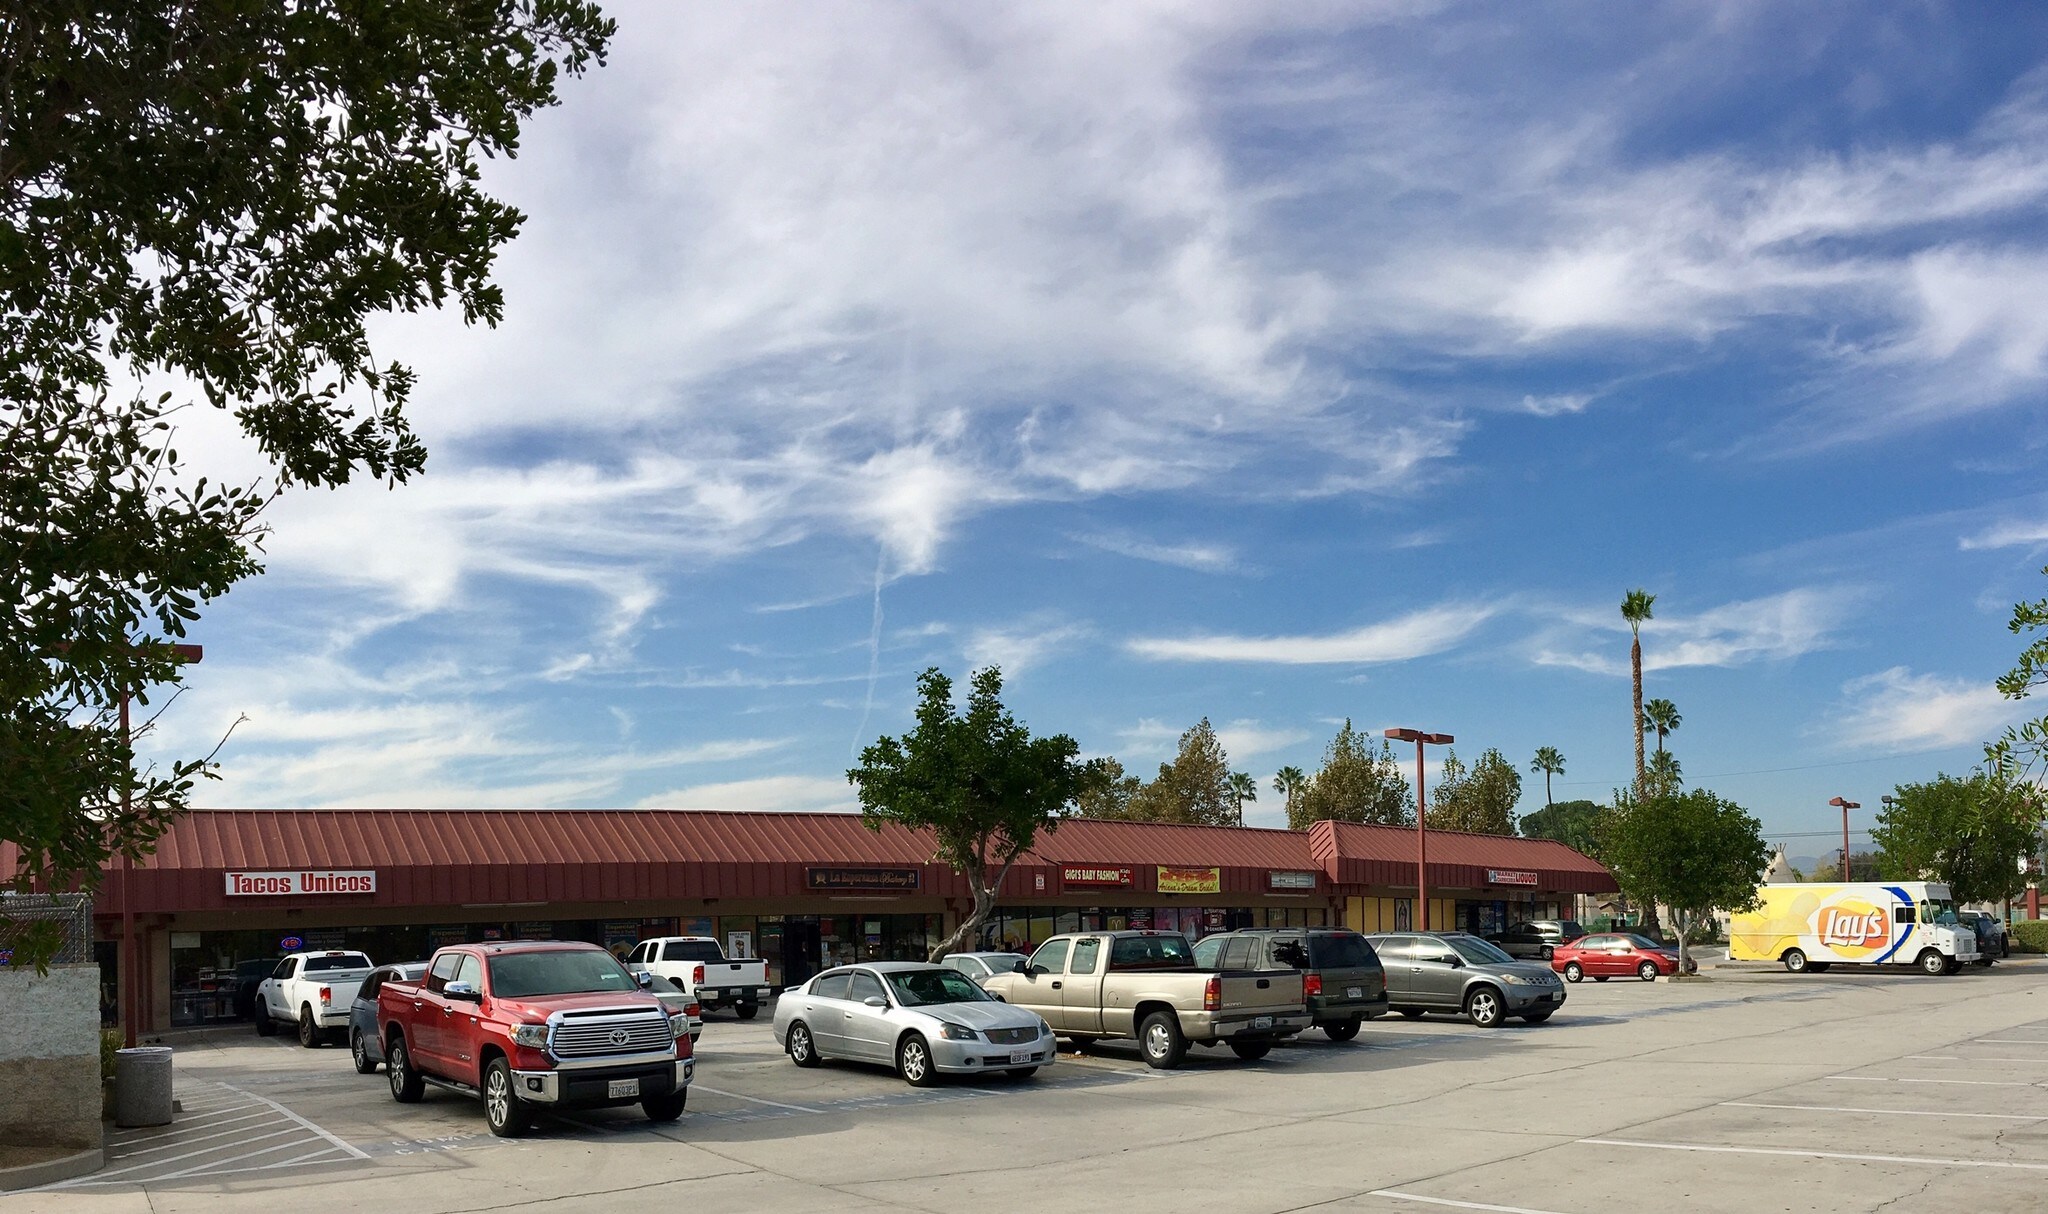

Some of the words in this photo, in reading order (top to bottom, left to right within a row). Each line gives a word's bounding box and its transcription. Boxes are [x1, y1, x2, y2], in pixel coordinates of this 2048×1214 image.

[230, 873, 292, 893] Tacos
[300, 872, 371, 892] Unicos
[1064, 869, 1081, 880] GIGI'S
[1082, 870, 1096, 881] BABY
[1097, 870, 1119, 881] FASHION
[1515, 873, 1537, 884] LIQUOR
[1824, 909, 1882, 946] Lay's
